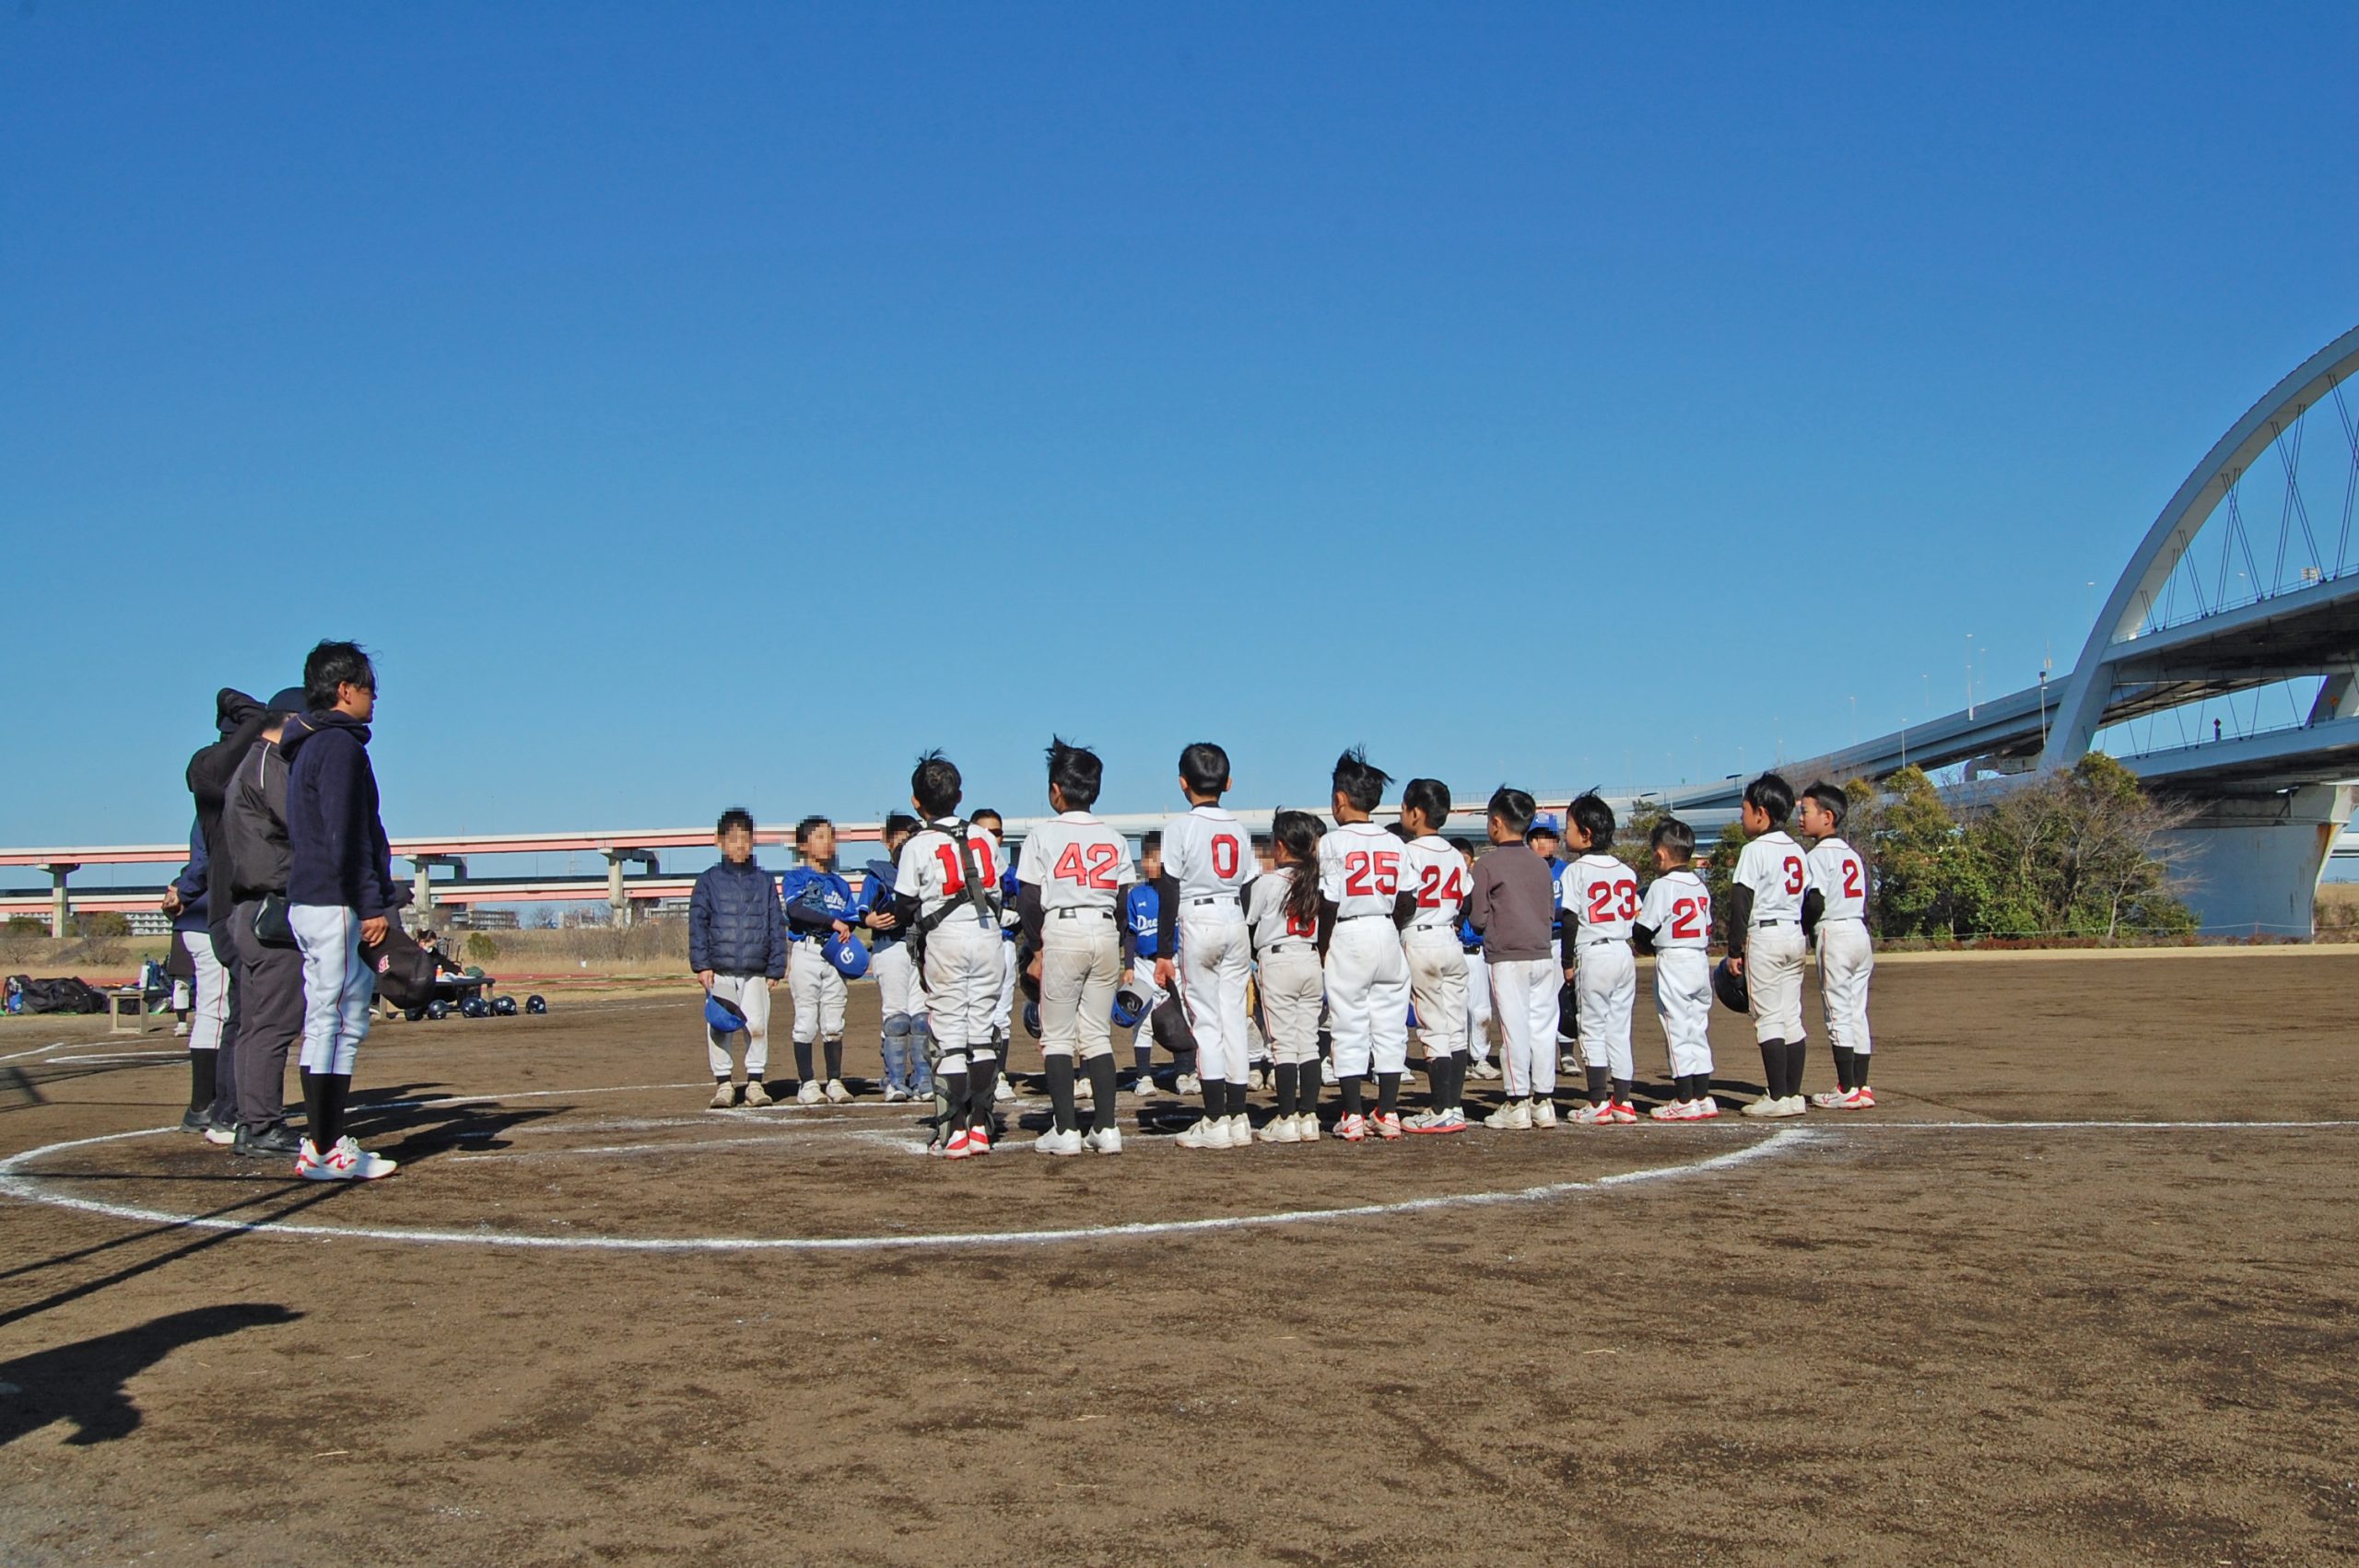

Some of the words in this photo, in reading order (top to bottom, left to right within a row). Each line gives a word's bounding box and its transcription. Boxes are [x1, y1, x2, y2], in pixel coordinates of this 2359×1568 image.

[1053, 842, 1118, 890] 42
[1211, 833, 1238, 879] 0
[1344, 850, 1400, 896] 25
[1783, 856, 1803, 895] 3
[1842, 859, 1863, 898] 2
[1416, 864, 1463, 911] 24
[1588, 879, 1637, 924] 23
